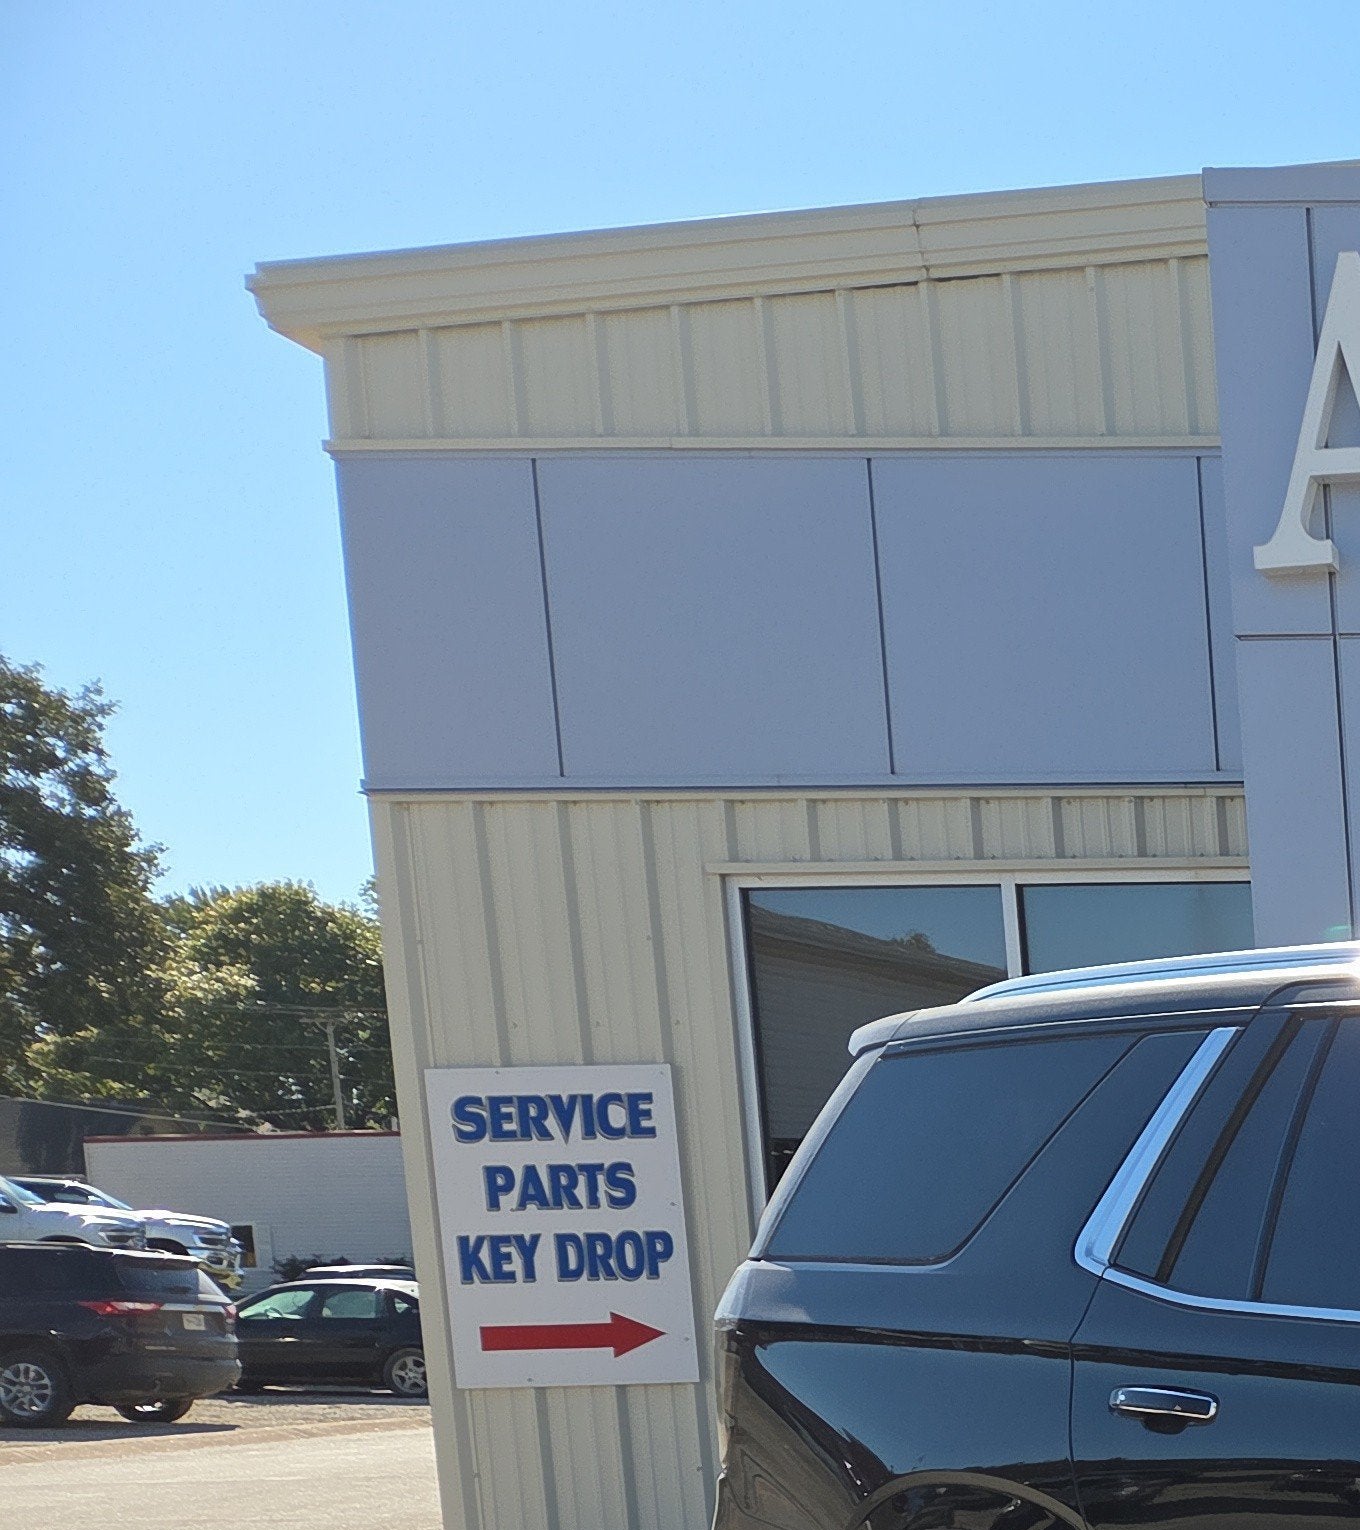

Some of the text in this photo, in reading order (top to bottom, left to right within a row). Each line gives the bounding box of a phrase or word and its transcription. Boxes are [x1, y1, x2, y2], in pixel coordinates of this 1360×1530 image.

[451, 1091, 657, 1145] SERVICE
[482, 1161, 637, 1212] PARTS
[456, 1229, 674, 1285] KEY DROP
